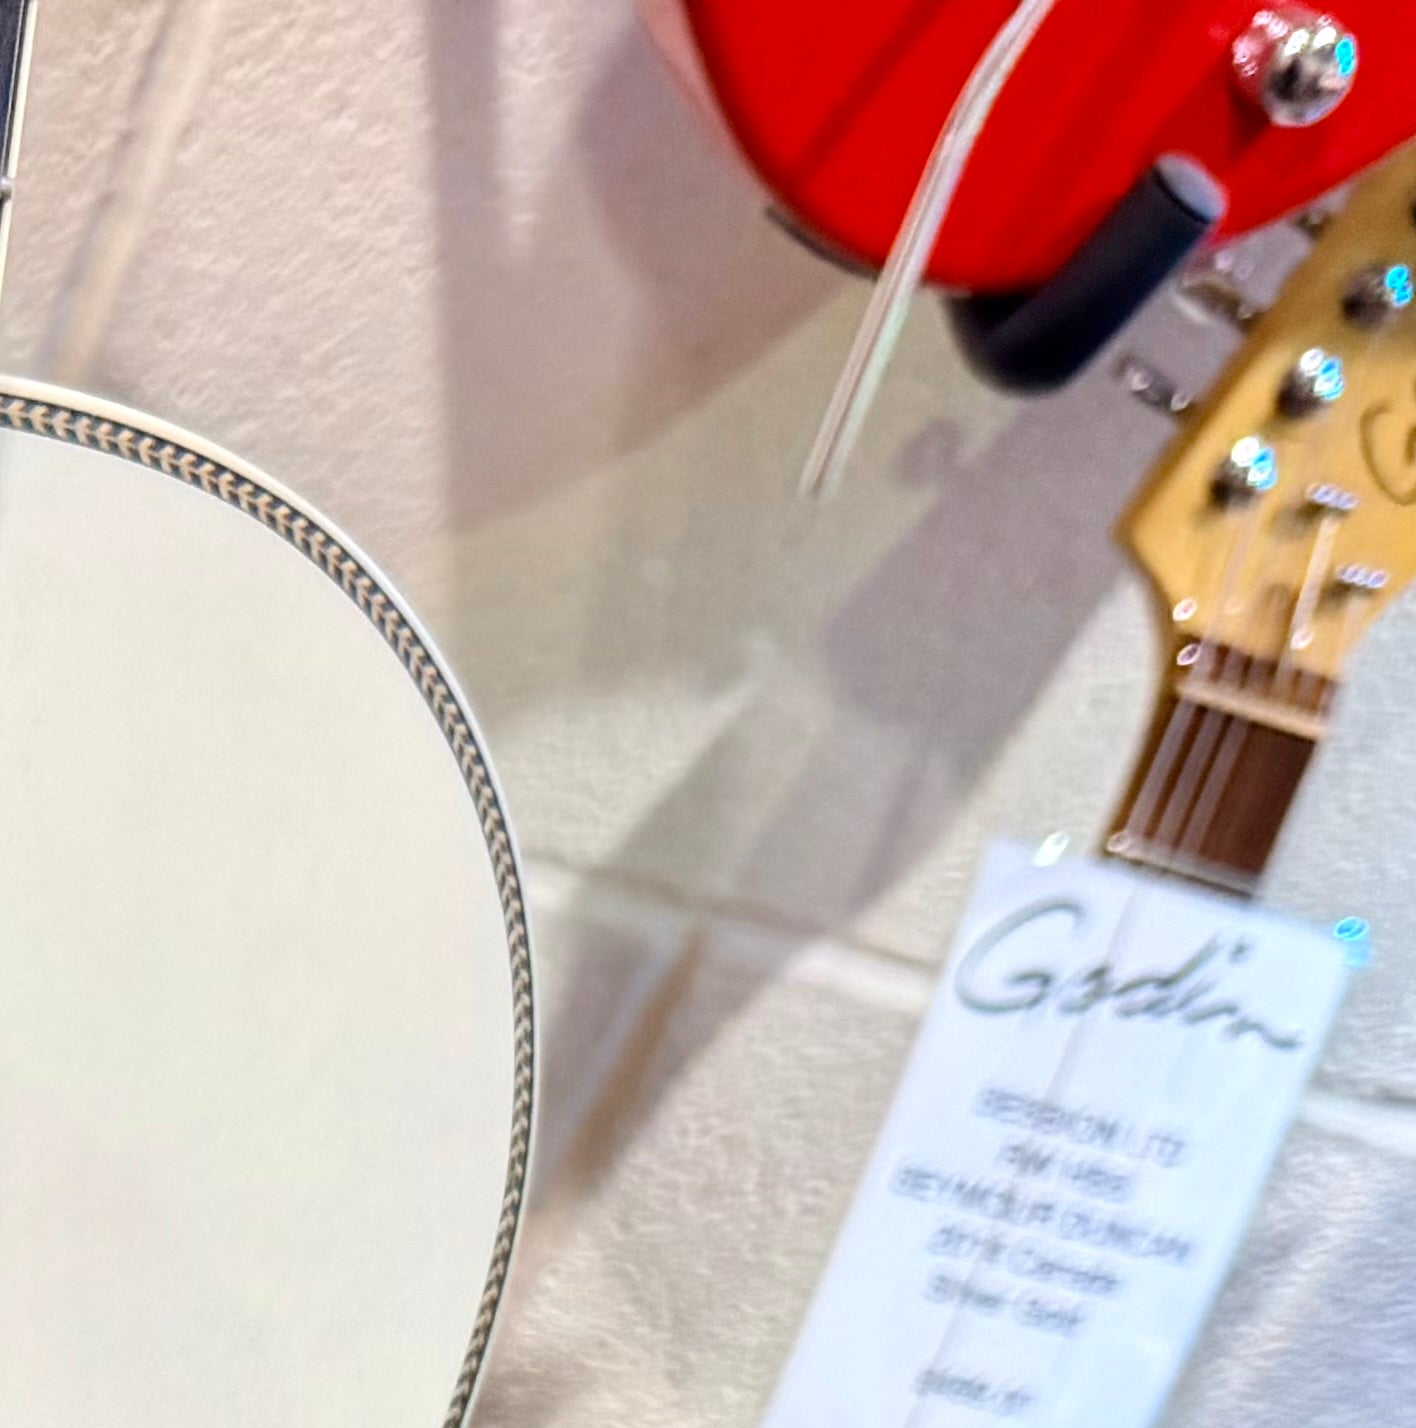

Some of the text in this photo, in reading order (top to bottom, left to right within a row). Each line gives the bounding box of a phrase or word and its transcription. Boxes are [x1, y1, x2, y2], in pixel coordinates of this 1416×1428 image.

[955, 897, 1304, 1050] Godin
[898, 1168, 1196, 1267] SEYMOUR DUNCAN
